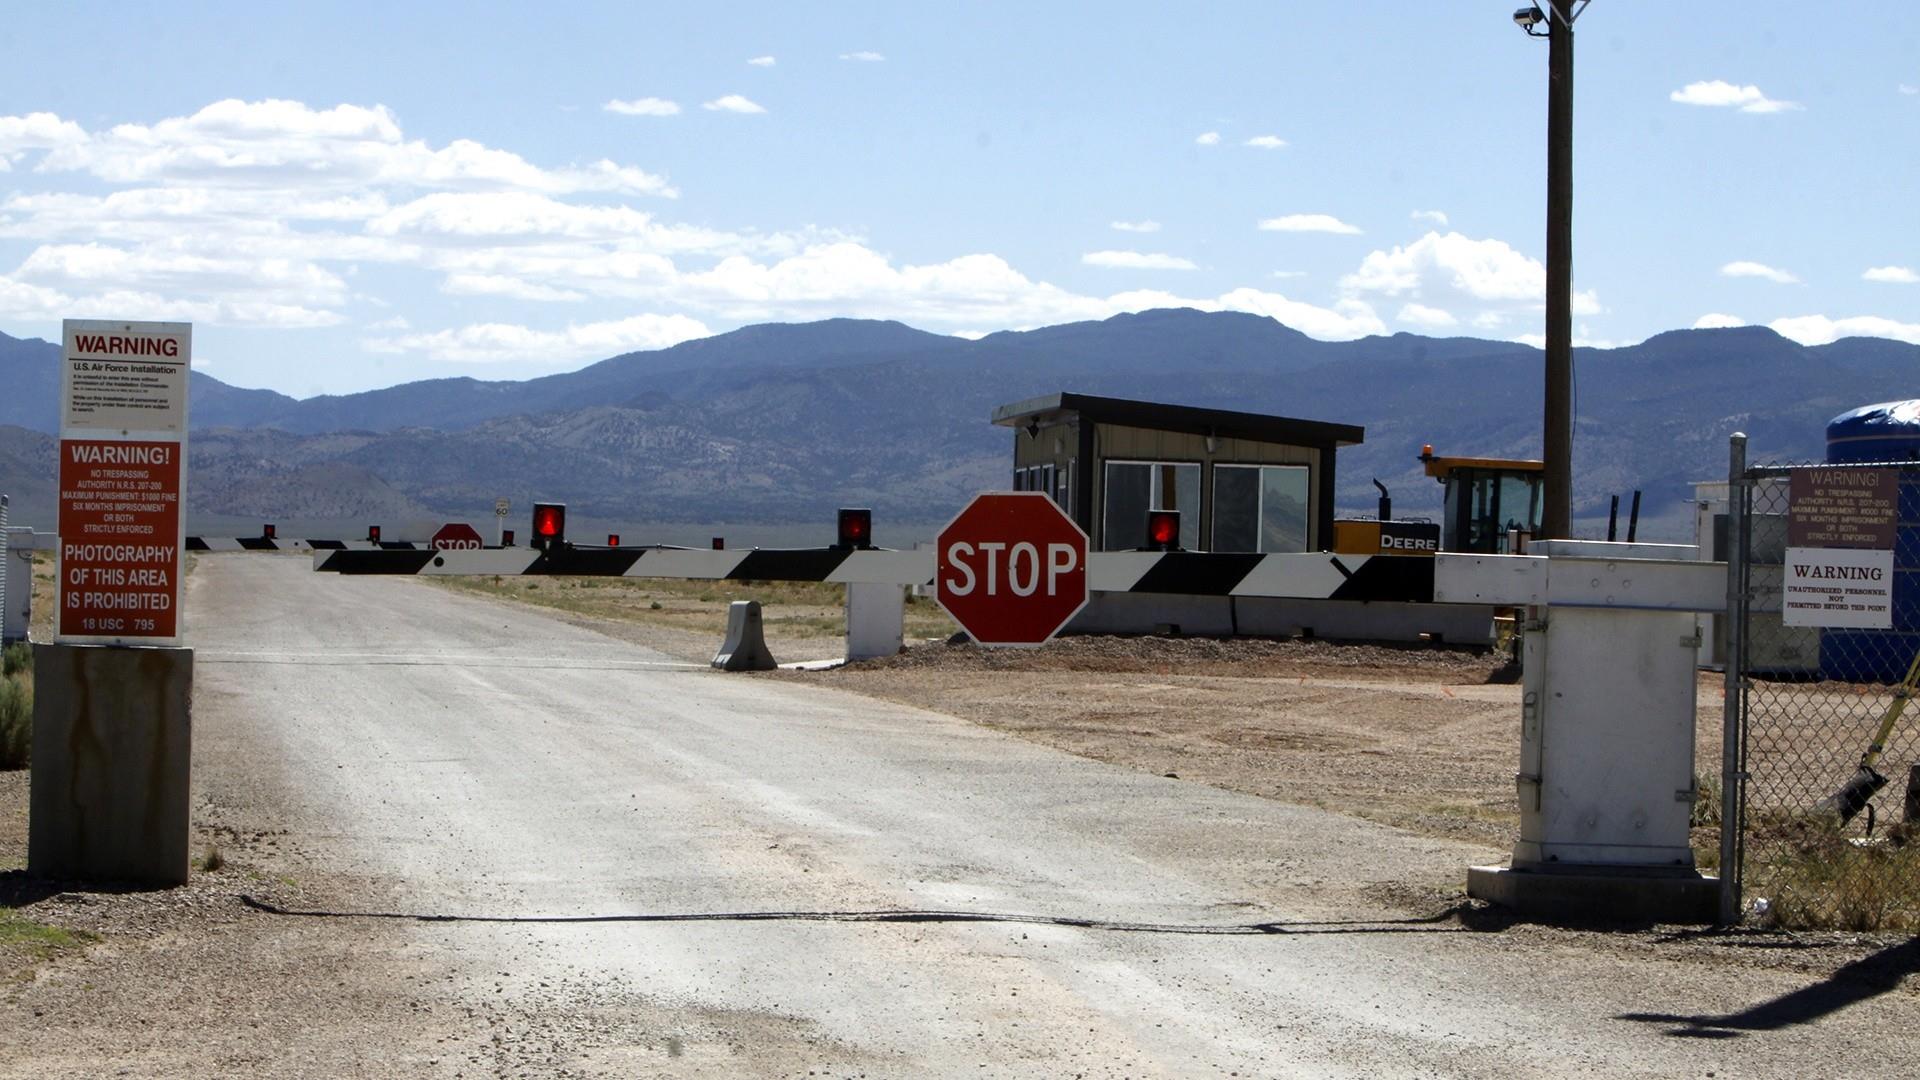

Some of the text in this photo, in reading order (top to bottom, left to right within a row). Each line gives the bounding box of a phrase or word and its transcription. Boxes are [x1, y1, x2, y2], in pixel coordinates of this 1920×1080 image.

[76, 335, 177, 356] WARNING
[74, 363, 89, 371] U.S.
[105, 364, 128, 372] Force
[131, 365, 176, 374] Installation
[72, 445, 169, 464] WARNING!
[103, 470, 149, 479] TRESPASSING
[1810, 472, 1879, 486] WARNING!
[77, 480, 162, 490] AUTHORITY N.R.S. 207-200
[63, 491, 94, 500] MAXIMUM
[142, 493, 160, 501] $1000
[161, 493, 176, 502] FINE
[1828, 489, 1872, 497] TRESPASSING
[73, 502, 166, 512] SIX MONTHS IMPRISONMENT
[1859, 499, 1889, 507] 207-200
[104, 514, 134, 522] OR BOTH
[1811, 515, 1837, 523] MONTHS
[1841, 516, 1888, 524] IMPRISONMENT
[84, 525, 153, 534] STRICTLY ENFORCED
[1381, 534, 1436, 550] DEERE
[1842, 534, 1877, 542] ENFORCED
[435, 539, 480, 550] STOP
[65, 544, 174, 562] PHOTOGRAPHY
[946, 541, 1077, 596] STOP
[1794, 565, 1882, 580] WARNING
[70, 568, 168, 586] OF THIS AREA
[1788, 586, 1887, 596] UNAUTHORIZED PERSONNEL
[68, 592, 169, 609] IS PROHIBITED
[83, 618, 155, 630] 18 USC 795
